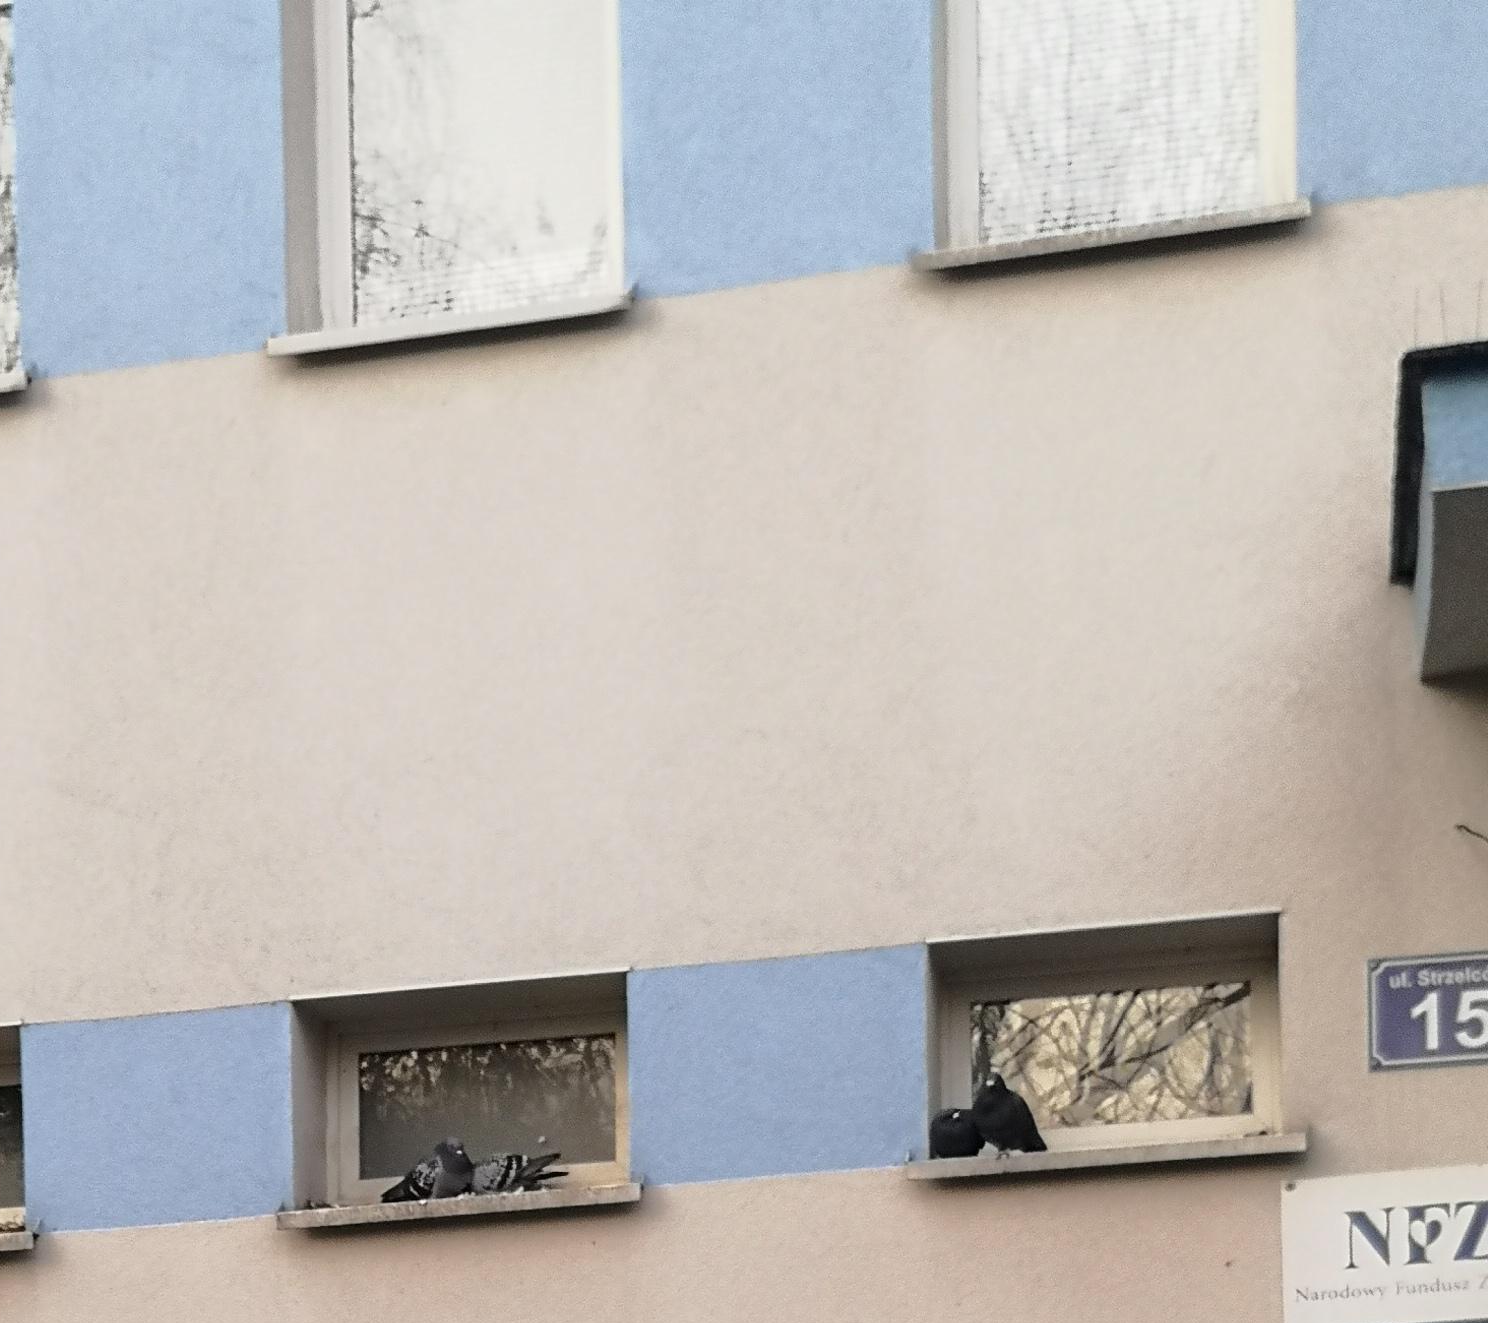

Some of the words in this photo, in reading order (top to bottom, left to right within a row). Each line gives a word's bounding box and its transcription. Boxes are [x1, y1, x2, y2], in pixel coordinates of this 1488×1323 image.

[1411, 990, 1488, 1050] 15
[1344, 1200, 1488, 1270] NFZ
[1295, 1284, 1385, 1302] Narodowy
[1395, 1278, 1469, 1296] Fundusz
